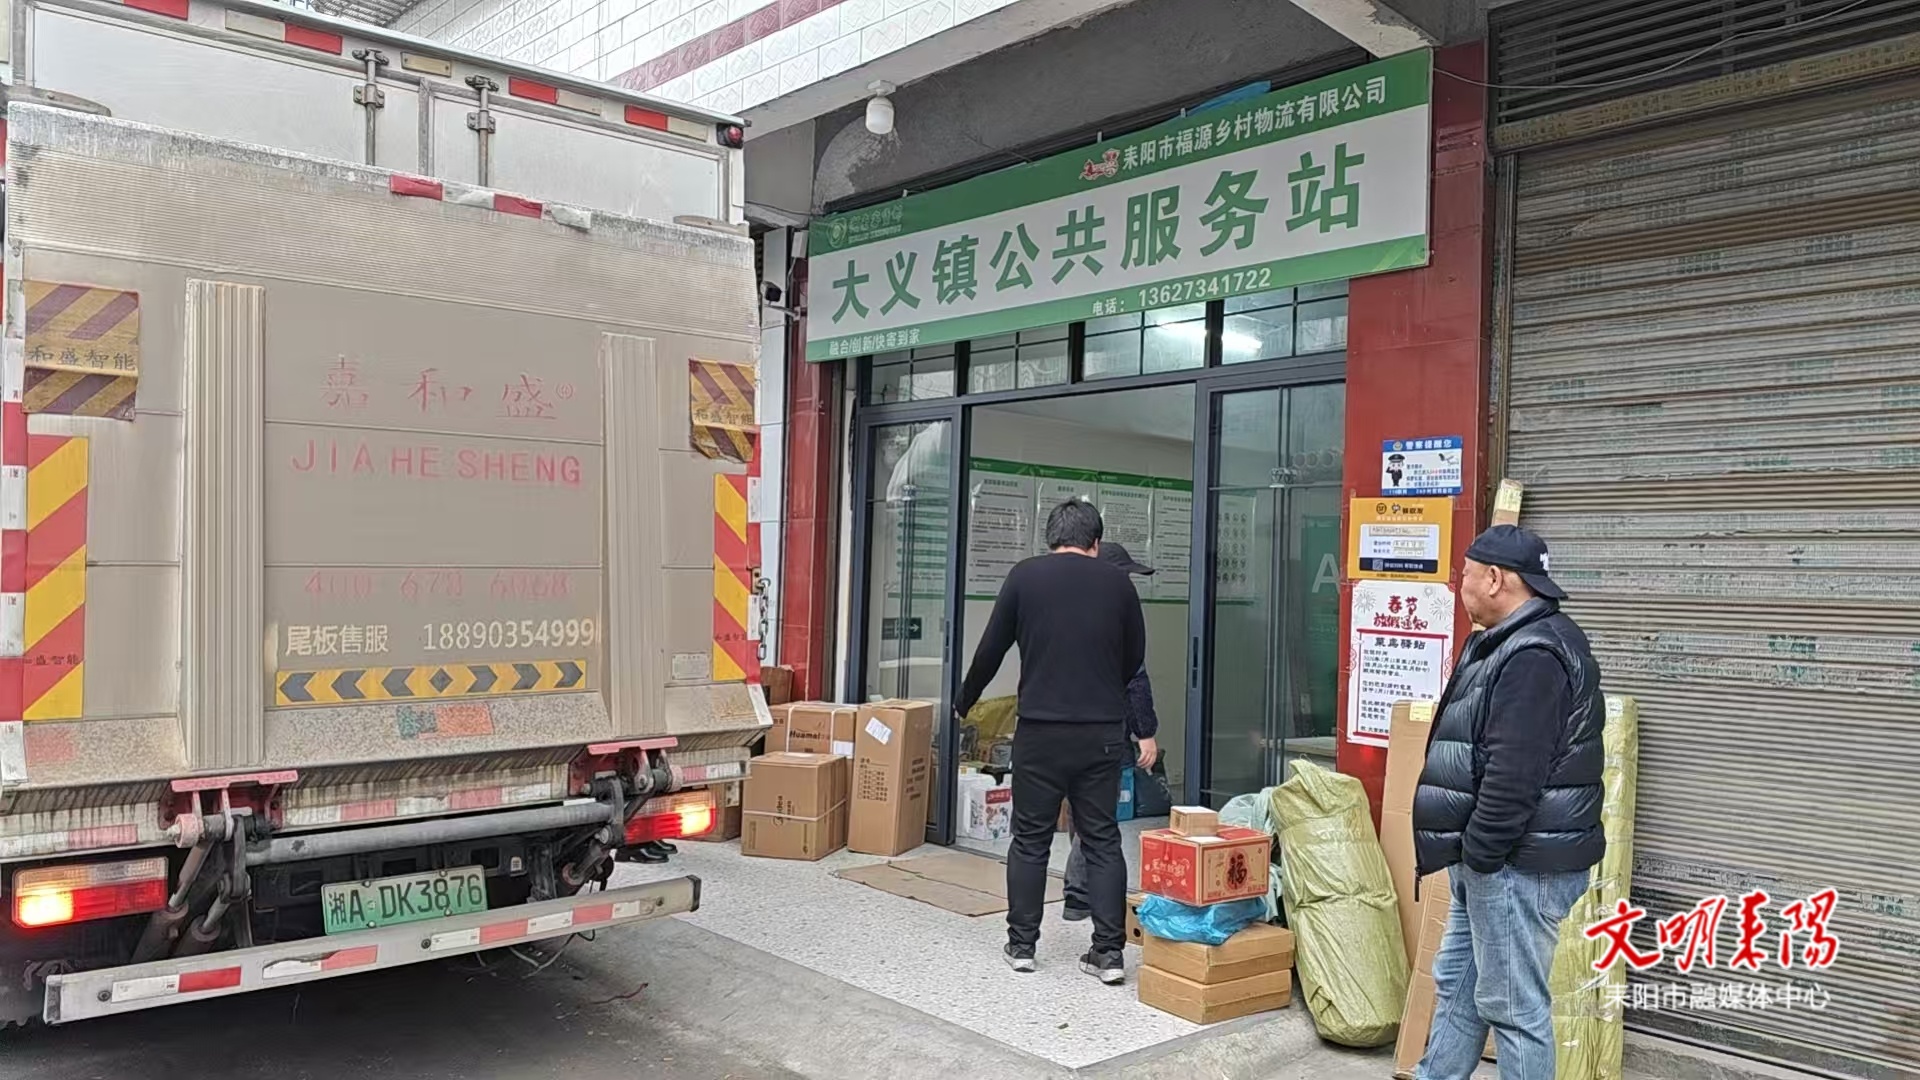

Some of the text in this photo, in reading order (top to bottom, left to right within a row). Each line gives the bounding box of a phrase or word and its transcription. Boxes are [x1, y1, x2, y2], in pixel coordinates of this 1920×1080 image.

[1122, 75, 1387, 171] 耒阳市福源乡村物流有限公司
[832, 143, 1366, 325] 大义镇公共服务站
[1138, 267, 1272, 307] 13627341722
[29, 344, 136, 371] 和盛智能
[829, 328, 921, 356] 融合/创新/快寄到家
[320, 353, 557, 420] 嘉和盛
[1373, 612, 1429, 630] 放假通知
[1388, 595, 1418, 615] 春节
[285, 618, 594, 657] 尾板售服 18890354999
[1227, 853, 1249, 889] 福
